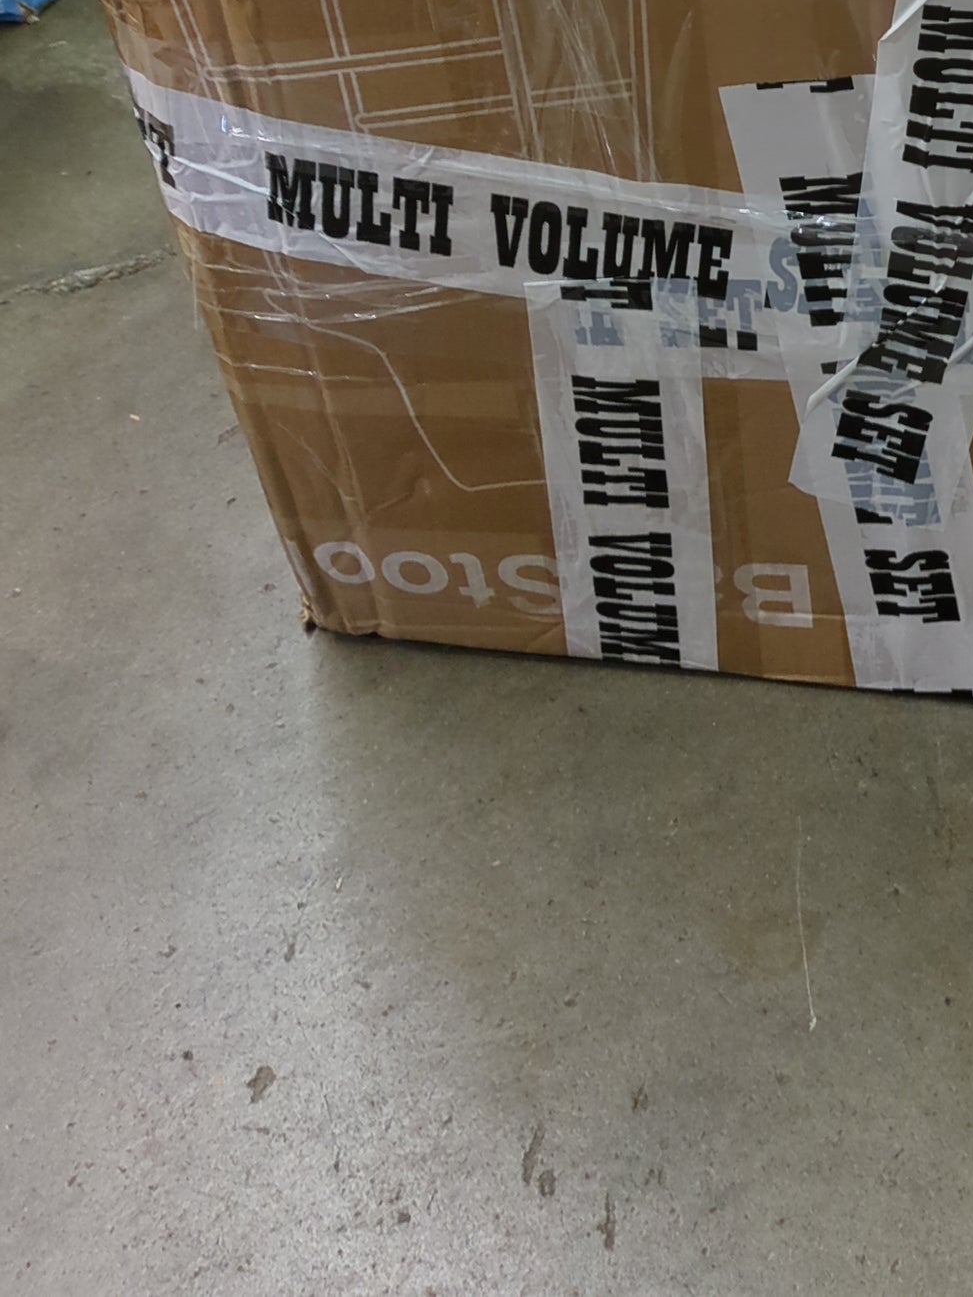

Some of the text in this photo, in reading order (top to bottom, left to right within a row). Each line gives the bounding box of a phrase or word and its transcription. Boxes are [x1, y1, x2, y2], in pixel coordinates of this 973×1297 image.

[264, 151, 454, 257] MULTI
[490, 193, 734, 301] VOLUME
[571, 375, 670, 509] MULTI
[830, 389, 934, 485] SET
[863, 549, 961, 624] SET
